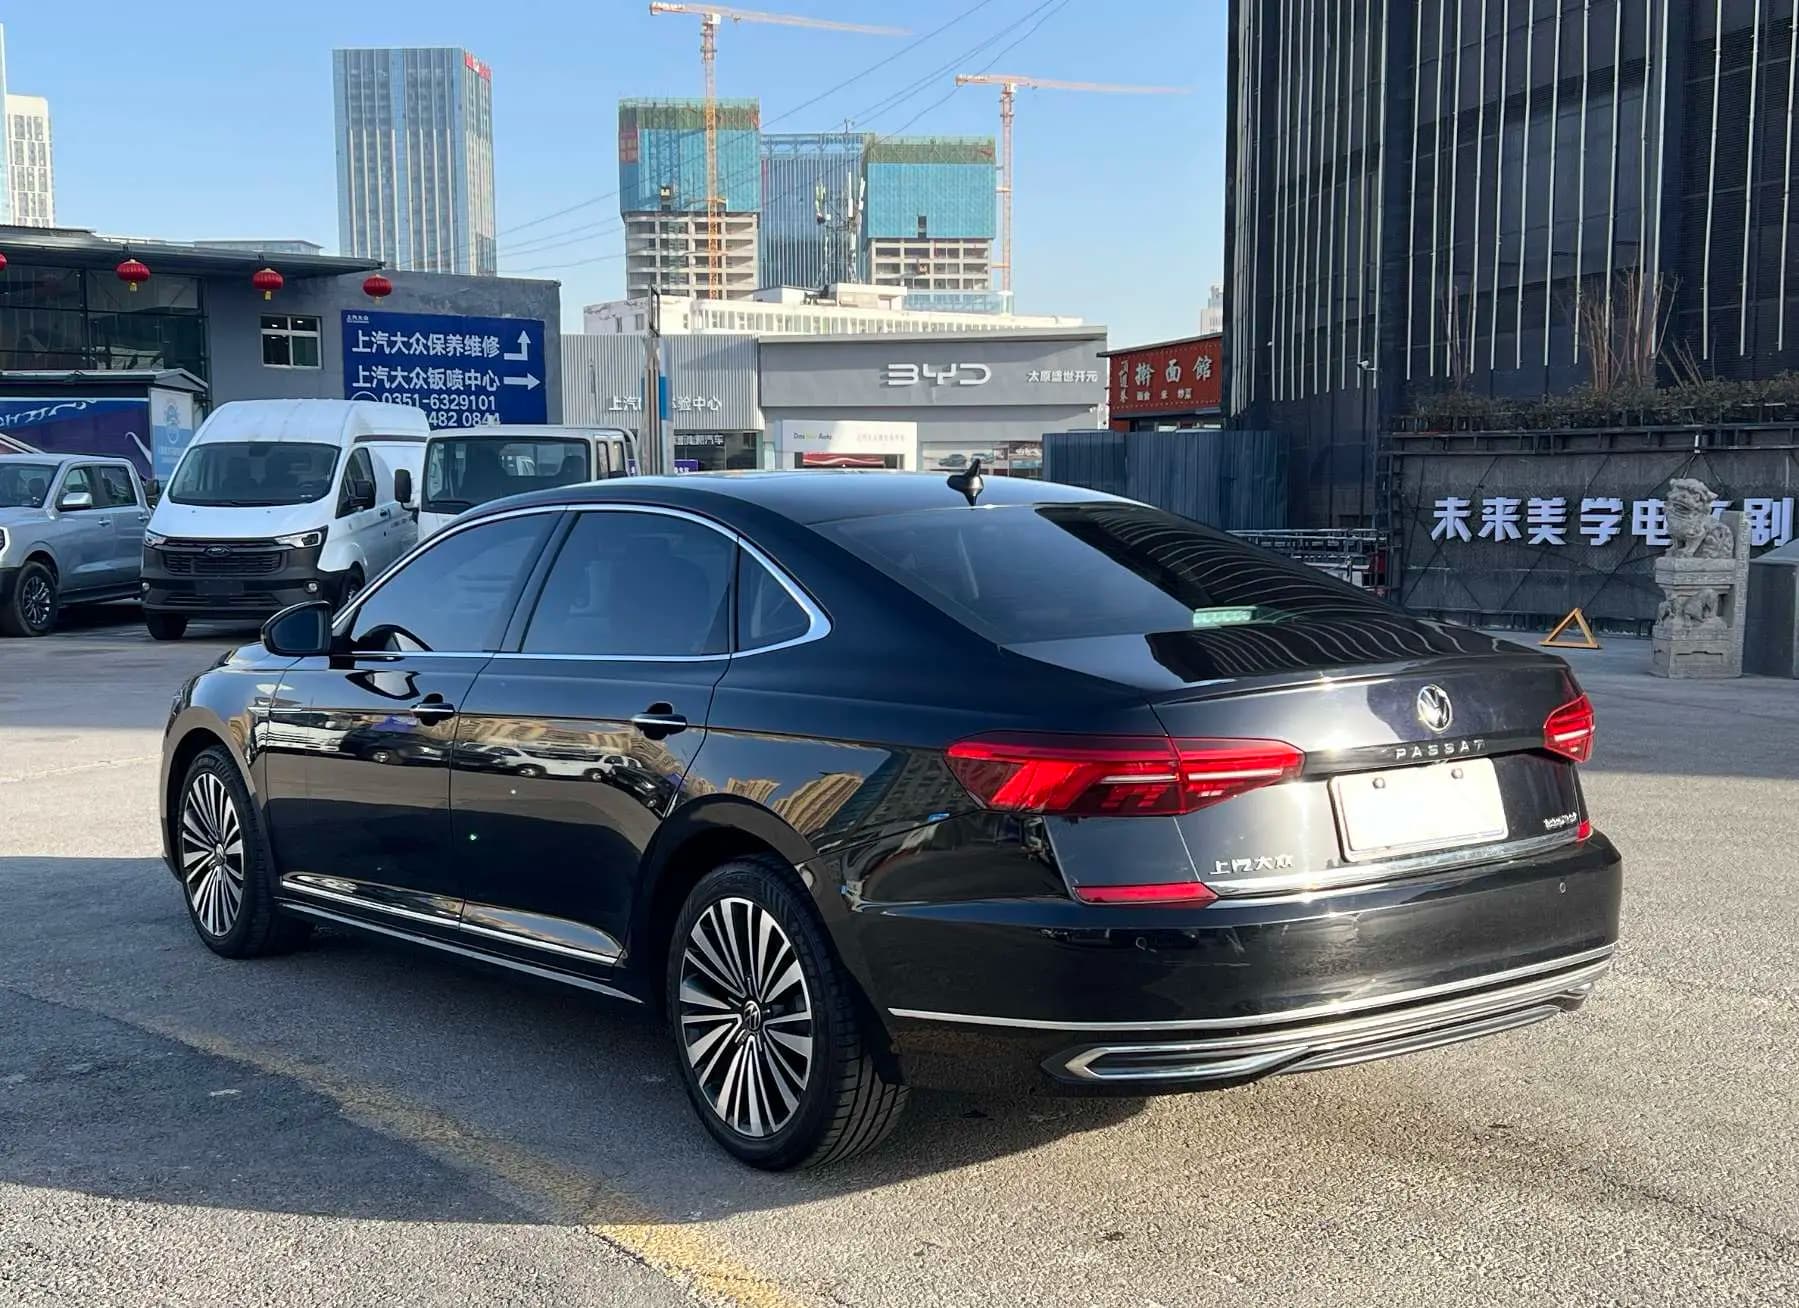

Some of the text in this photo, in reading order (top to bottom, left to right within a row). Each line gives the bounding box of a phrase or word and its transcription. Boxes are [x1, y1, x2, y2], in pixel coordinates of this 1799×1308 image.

[352, 330, 500, 358] 上汽大众保养维修
[352, 365, 500, 392] 上汽大众钣喷中心
[887, 363, 992, 386] BYD
[1028, 370, 1098, 383] 太原盛世开元
[382, 393, 497, 411] 0351-6329101
[1395, 739, 1486, 760] PASSAT
